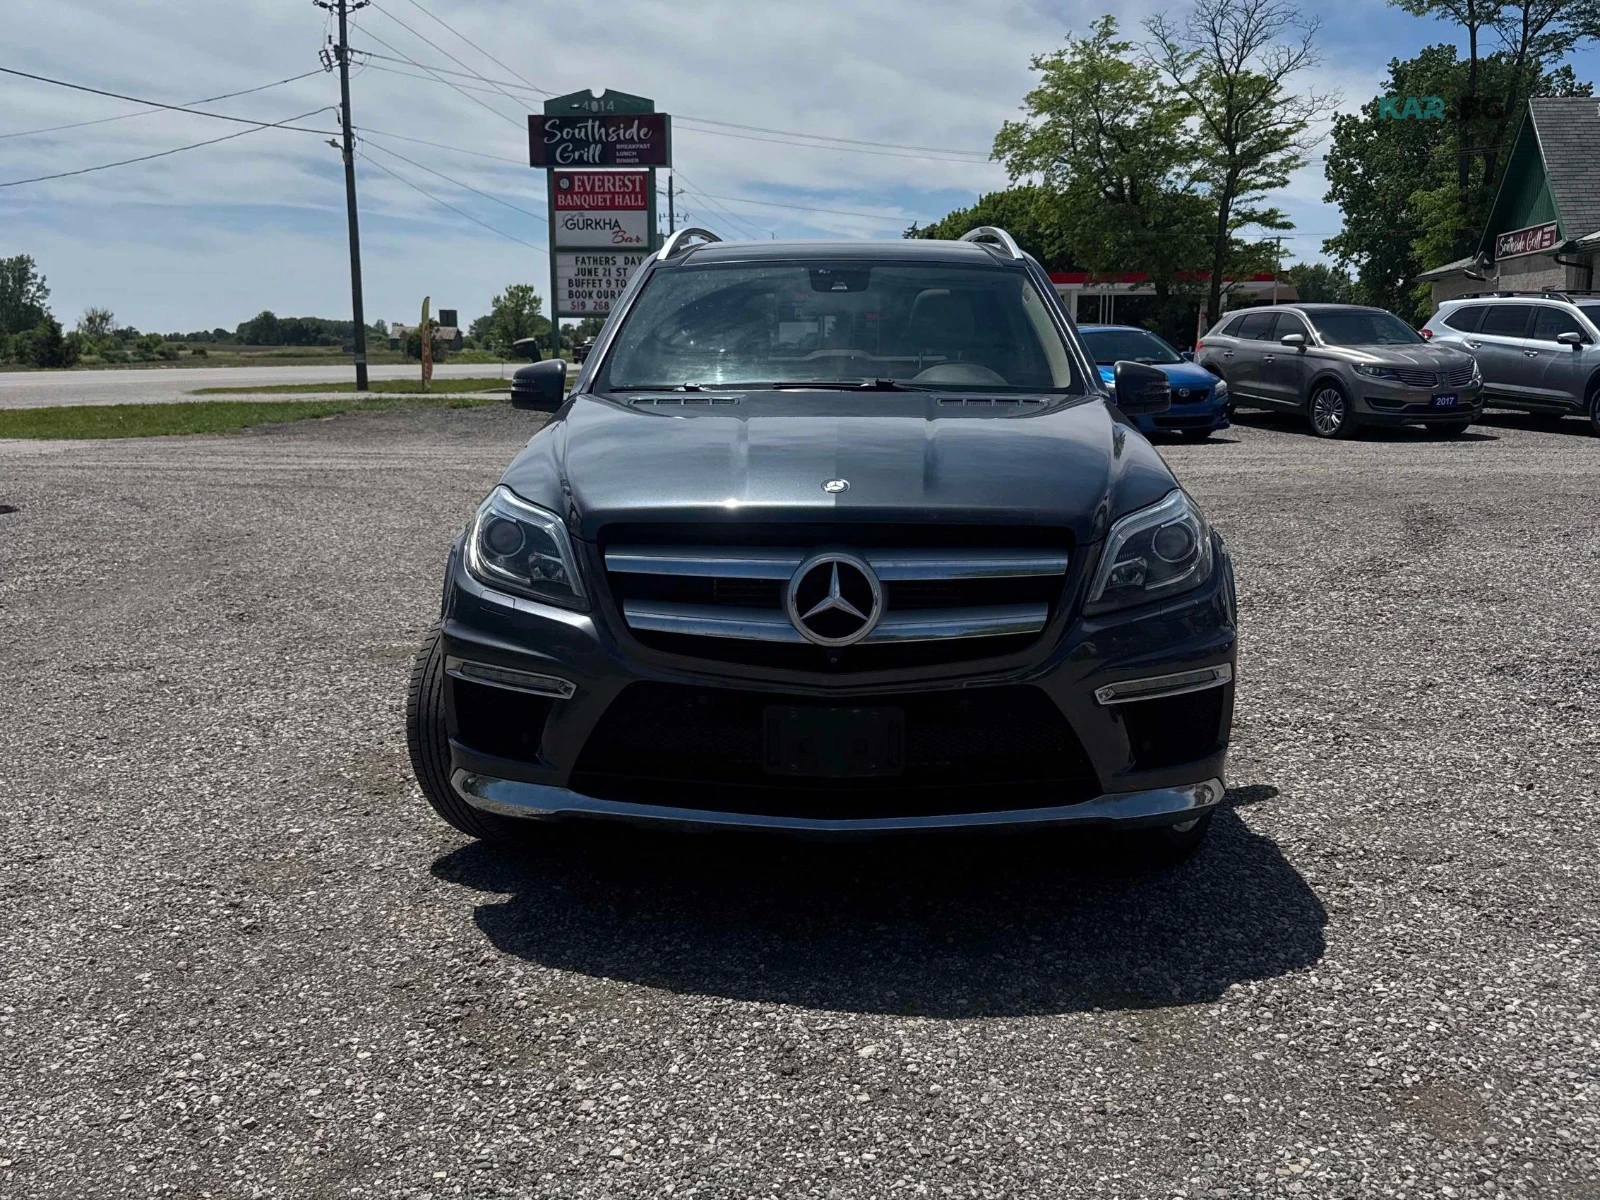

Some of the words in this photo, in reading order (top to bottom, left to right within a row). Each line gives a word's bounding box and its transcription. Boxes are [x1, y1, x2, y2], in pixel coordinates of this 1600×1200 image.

[582, 100, 616, 112] 4014
[544, 119, 652, 144] Southside
[555, 143, 602, 164] Grill
[574, 175, 643, 193] EVEREST
[557, 194, 612, 209] BANQUET
[614, 193, 645, 206] HALL
[565, 218, 622, 231] GURKHA
[611, 230, 643, 244] Bar
[575, 256, 617, 266] FATHERS
[624, 256, 643, 266] DAY
[574, 267, 599, 277] JUNE
[602, 268, 611, 277] 21
[616, 267, 628, 277] ST
[568, 279, 602, 288] BUFFET
[606, 279, 612, 288] 9
[615, 279, 627, 288] TO
[568, 290, 594, 299] BOOK
[596, 290, 616, 299] OUR
[570, 301, 586, 311] 519
[593, 301, 610, 311] 268
[1436, 396, 1455, 406] 2017
